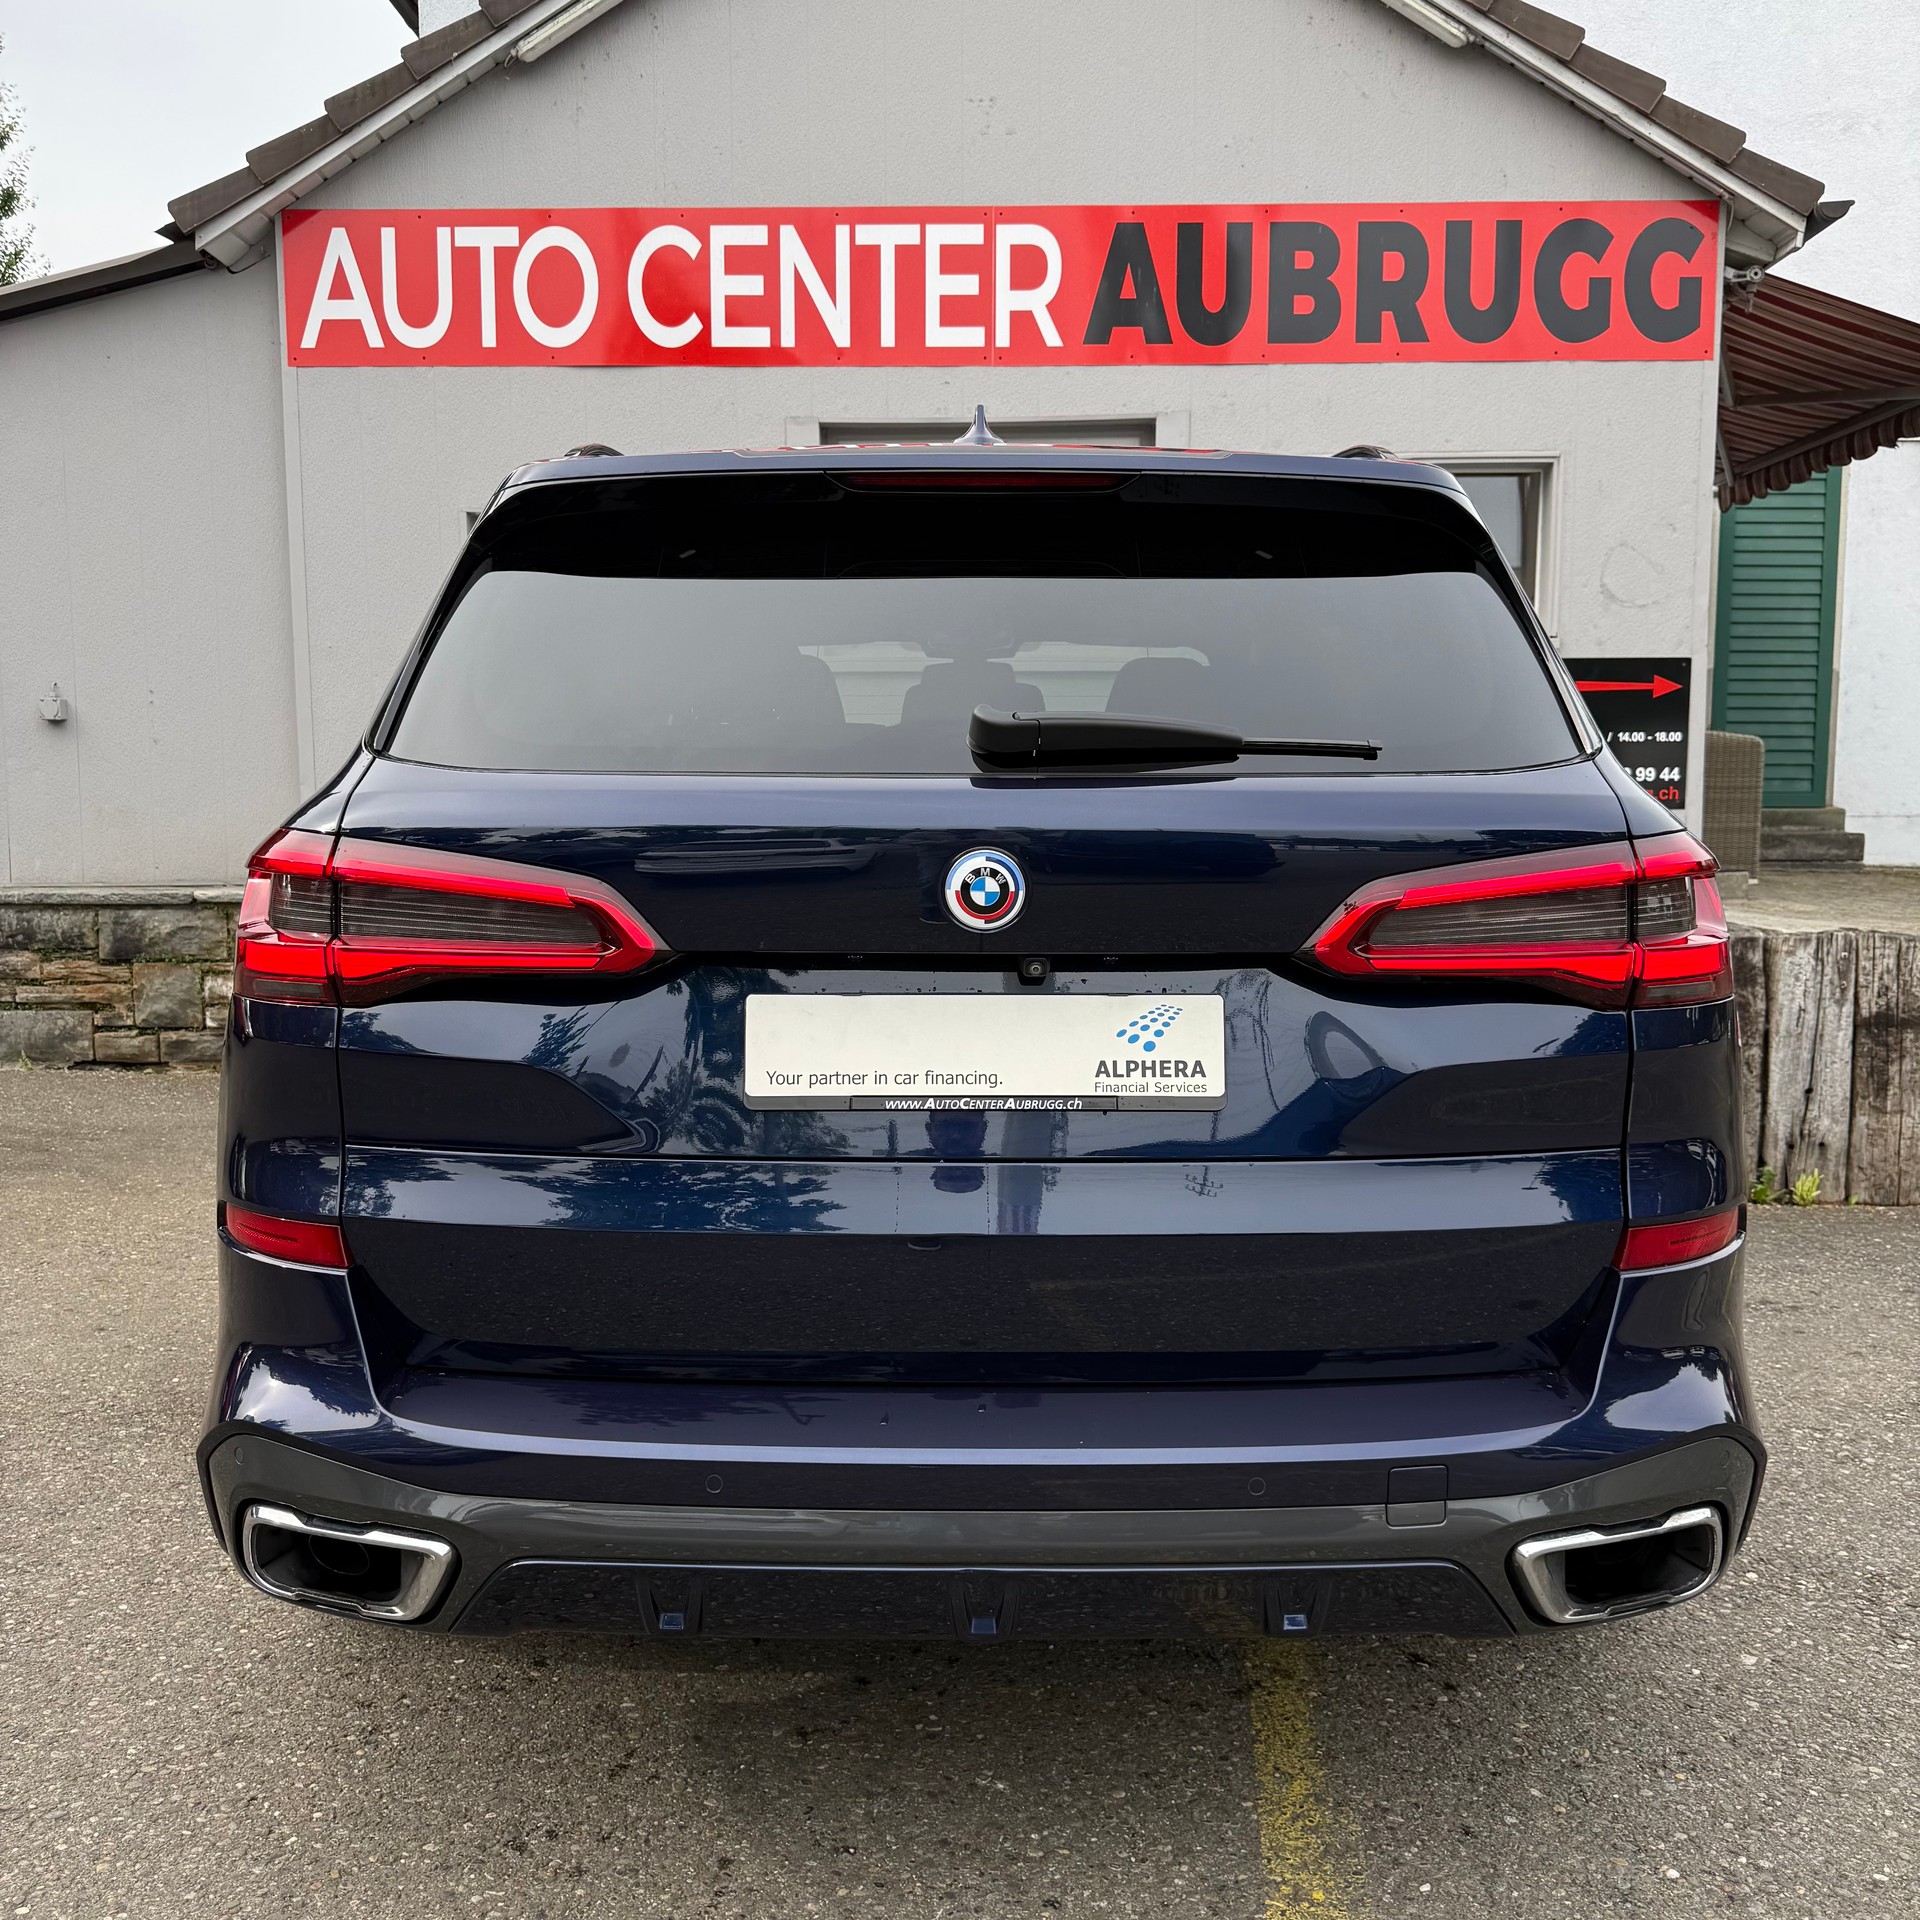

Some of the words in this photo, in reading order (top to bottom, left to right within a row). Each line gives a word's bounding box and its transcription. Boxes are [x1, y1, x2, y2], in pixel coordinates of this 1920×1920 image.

[300, 225, 599, 350] AUTO
[627, 222, 1064, 350] CENTER
[1082, 217, 1706, 348] AUBRUGG
[1617, 731, 1646, 743] 14.00
[1654, 731, 1683, 743] 18.00
[1635, 766, 1656, 782] 99
[1659, 766, 1681, 782] 44
[965, 867, 1006, 884] BMW
[1094, 1060, 1207, 1078] ALPHERA
[766, 1071, 803, 1085] Your
[809, 1071, 868, 1089] partner
[874, 1071, 888, 1085] in
[894, 1073, 919, 1085] car
[925, 1070, 1003, 1089] financing.
[1094, 1081, 1149, 1093] Financial
[1154, 1081, 1208, 1093] Services
